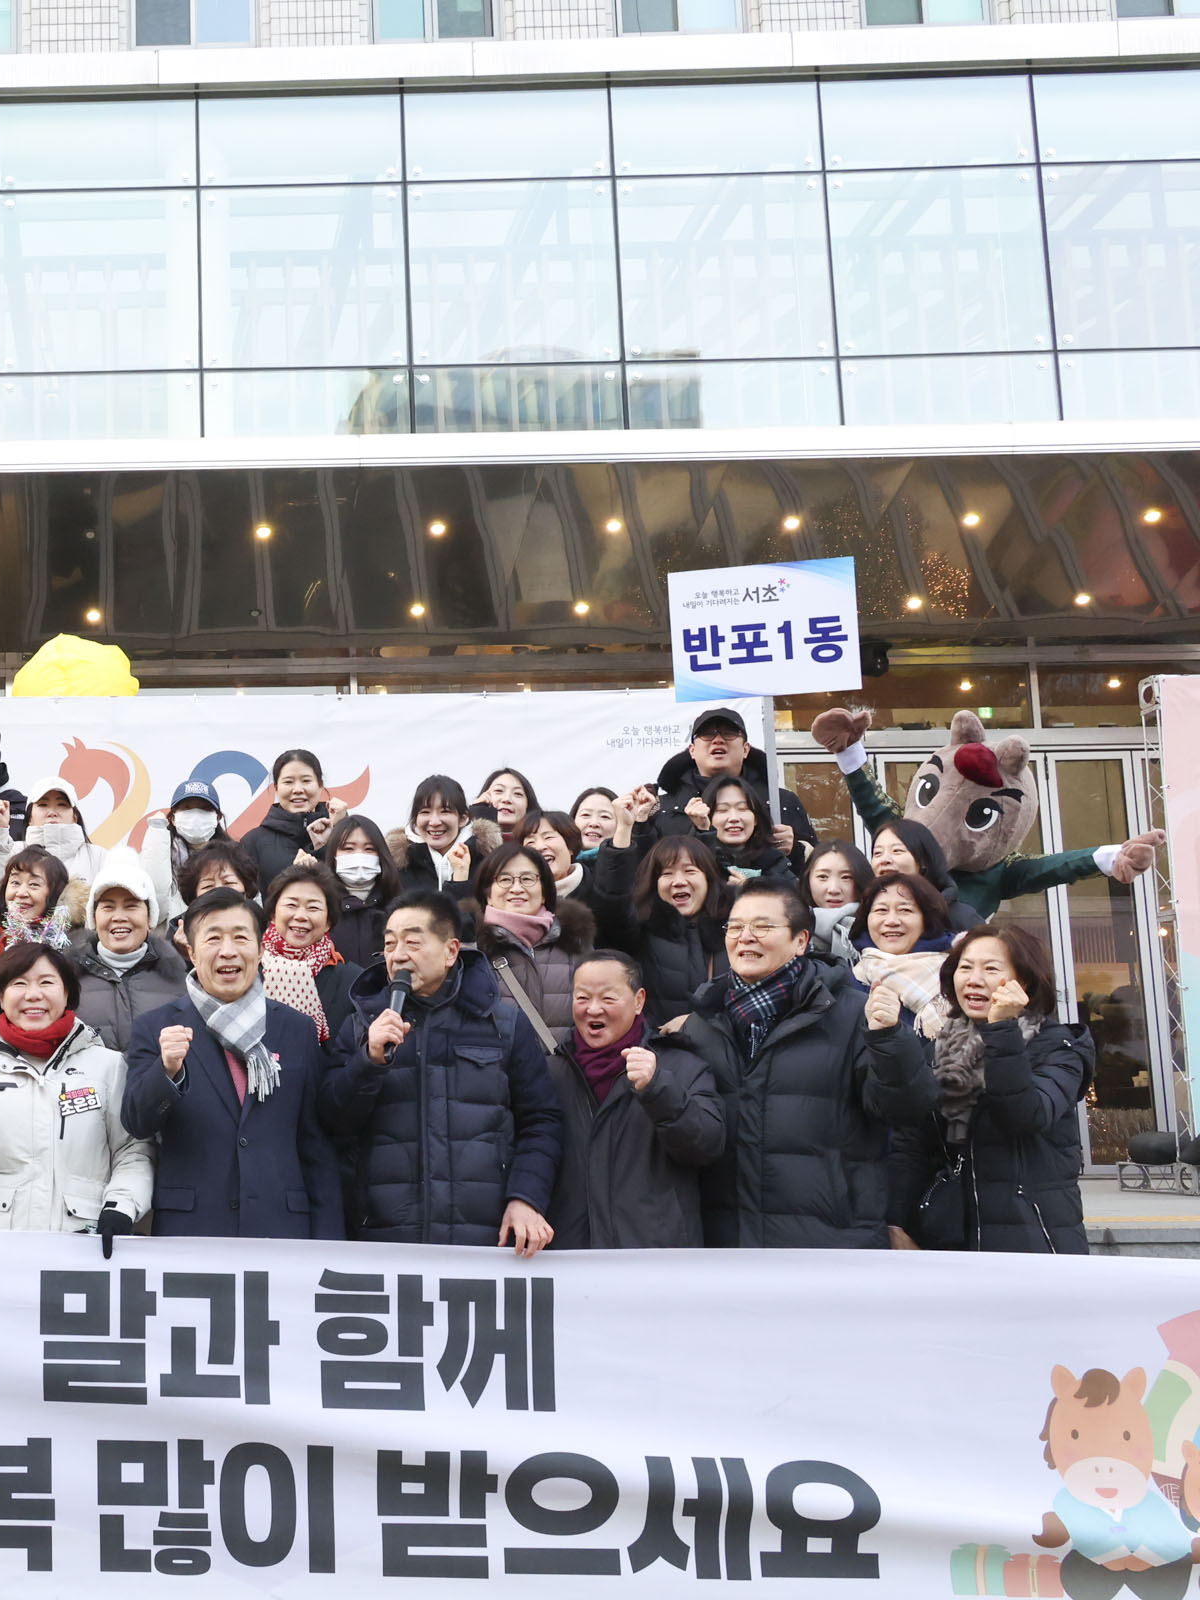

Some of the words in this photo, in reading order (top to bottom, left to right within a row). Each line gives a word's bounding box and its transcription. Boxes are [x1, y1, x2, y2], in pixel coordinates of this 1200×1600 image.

[742, 584, 780, 604] 서초
[683, 615, 849, 673] 반포1동
[622, 725, 641, 736] 오늘
[643, 724, 681, 736] 행복하고
[606, 737, 633, 749] 내일이
[636, 736, 681, 748] 기다려지는
[59, 1094, 102, 1116] 조은희
[40, 1267, 280, 1406] 말과
[314, 1267, 557, 1412] 함께
[97, 1438, 337, 1576] 많이
[376, 1449, 882, 1581] 받으세요
